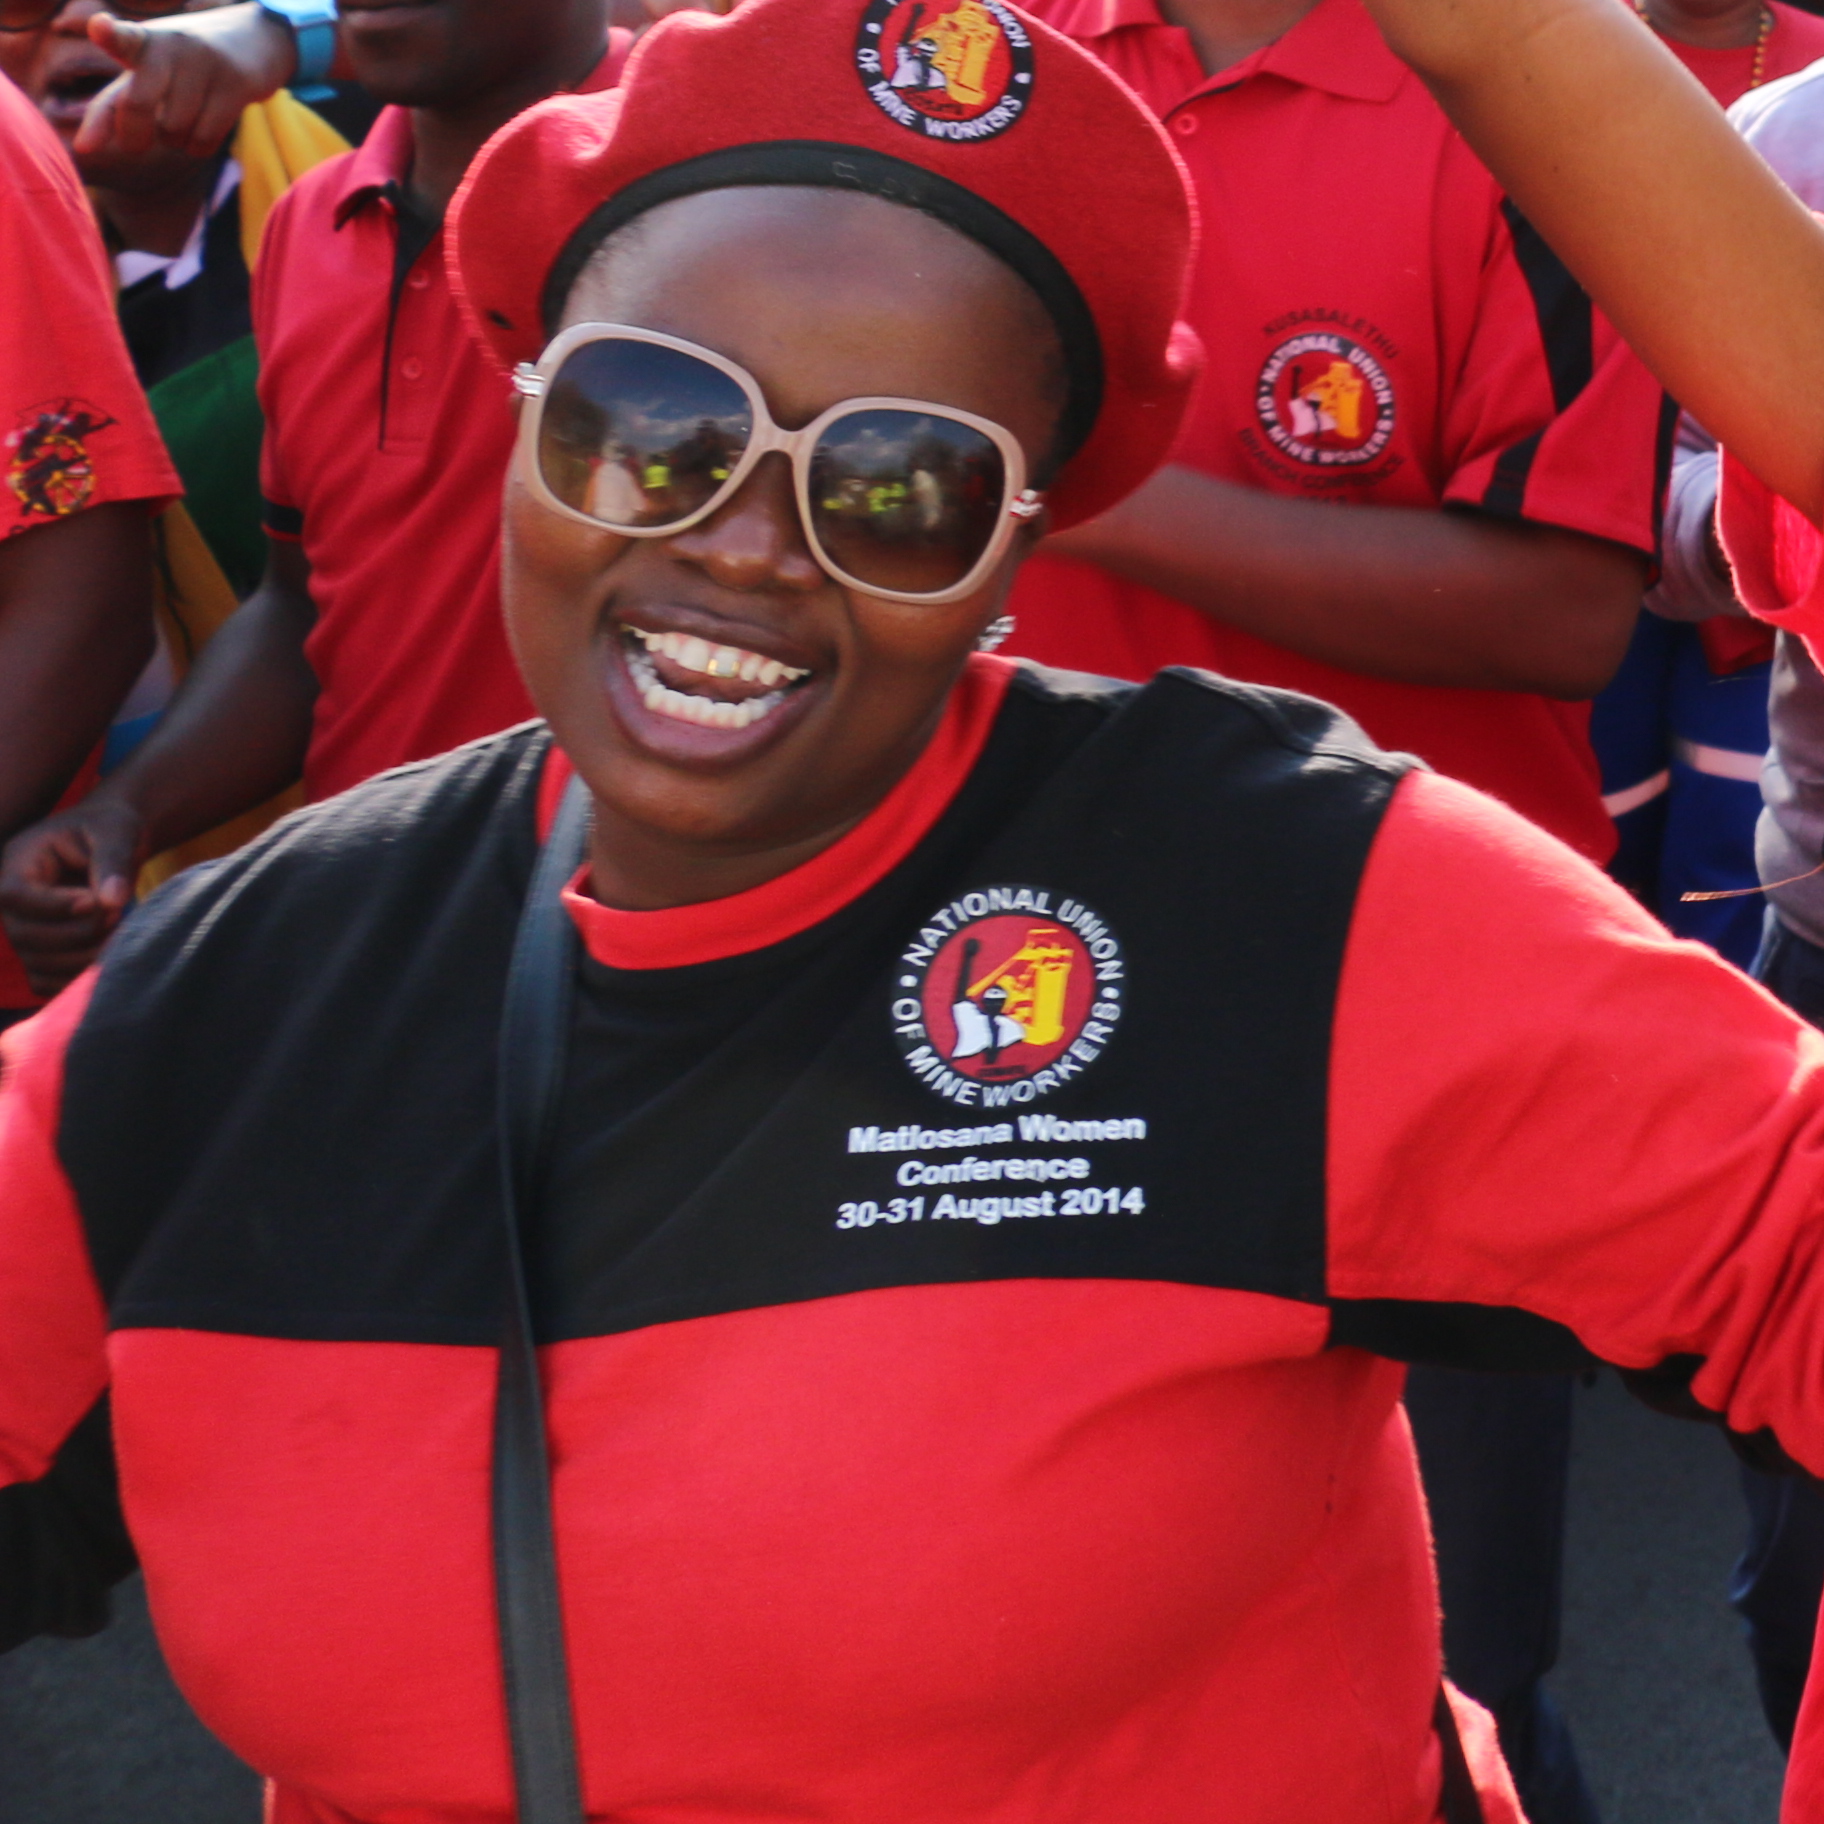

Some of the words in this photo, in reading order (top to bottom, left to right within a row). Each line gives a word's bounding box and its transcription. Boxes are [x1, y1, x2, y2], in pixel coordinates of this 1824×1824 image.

[901, 887, 1053, 968] NATIONAL
[1056, 899, 1125, 981] UNION
[892, 997, 927, 1040] OF
[904, 1044, 981, 1106] MINE
[981, 1004, 1122, 1108] WORKERS
[847, 1123, 1013, 1154] Matlosana
[1017, 1114, 1147, 1143] Women
[896, 1155, 1091, 1187] Conference
[835, 1196, 925, 1230] 30-31
[931, 1191, 1056, 1225] August
[1060, 1186, 1146, 1218] 2014
